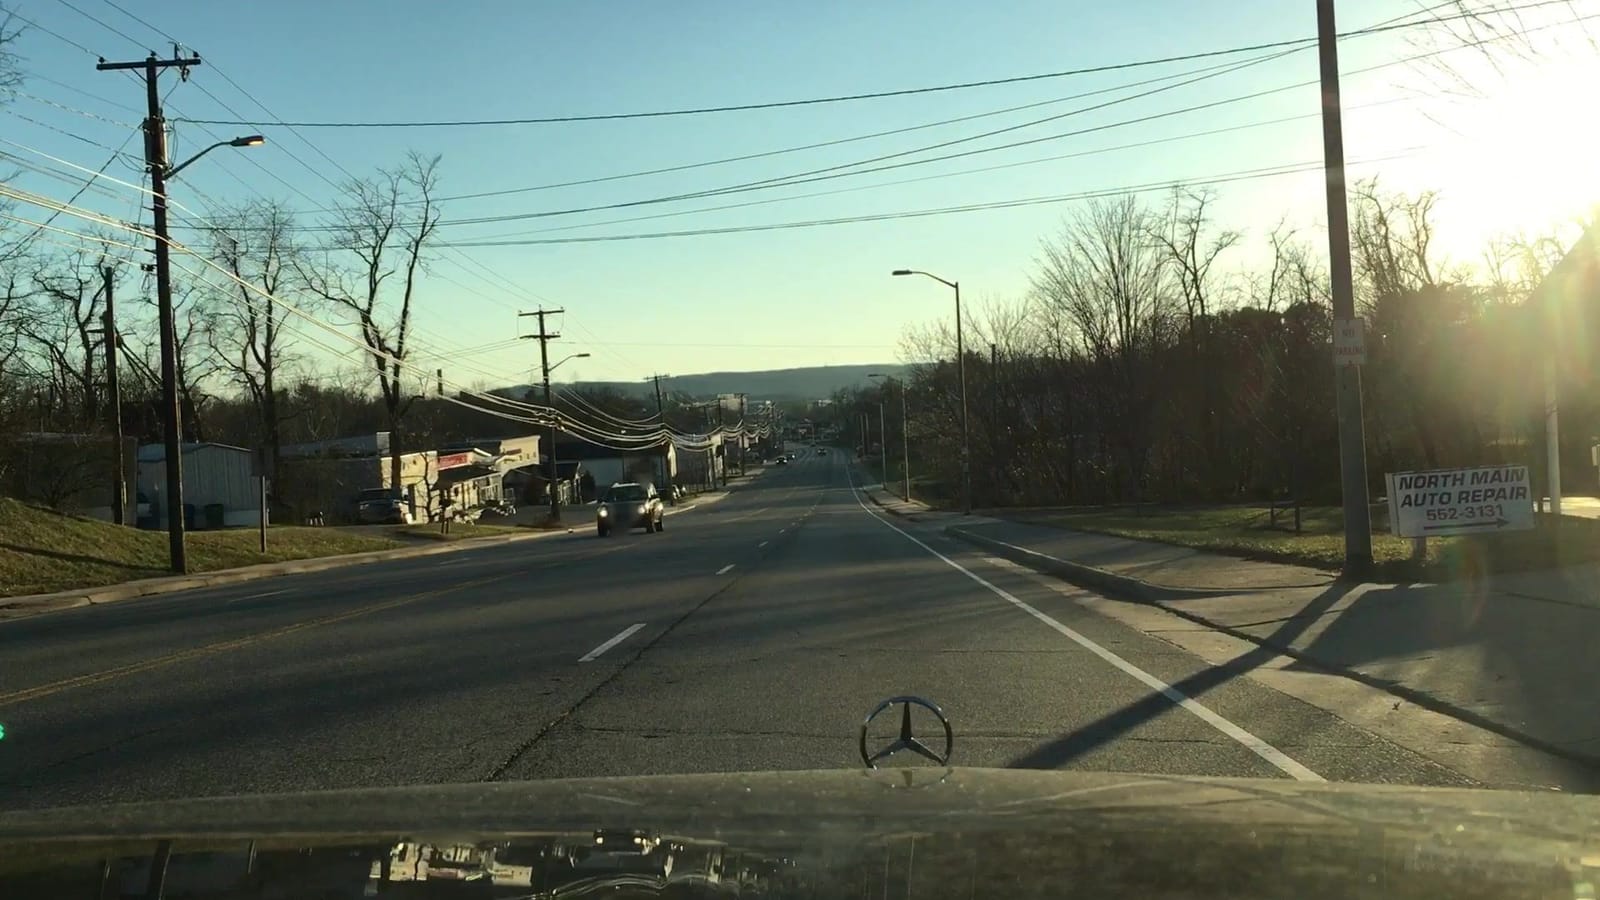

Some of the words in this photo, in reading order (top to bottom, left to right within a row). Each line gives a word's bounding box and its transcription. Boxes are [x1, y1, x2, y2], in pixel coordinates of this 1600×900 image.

[1400, 472, 1465, 490] NORTH
[1470, 468, 1525, 485] MAIN
[1401, 492, 1452, 508] AUTO
[1458, 486, 1527, 504] REPAIR
[1426, 504, 1504, 521] 552-3131
